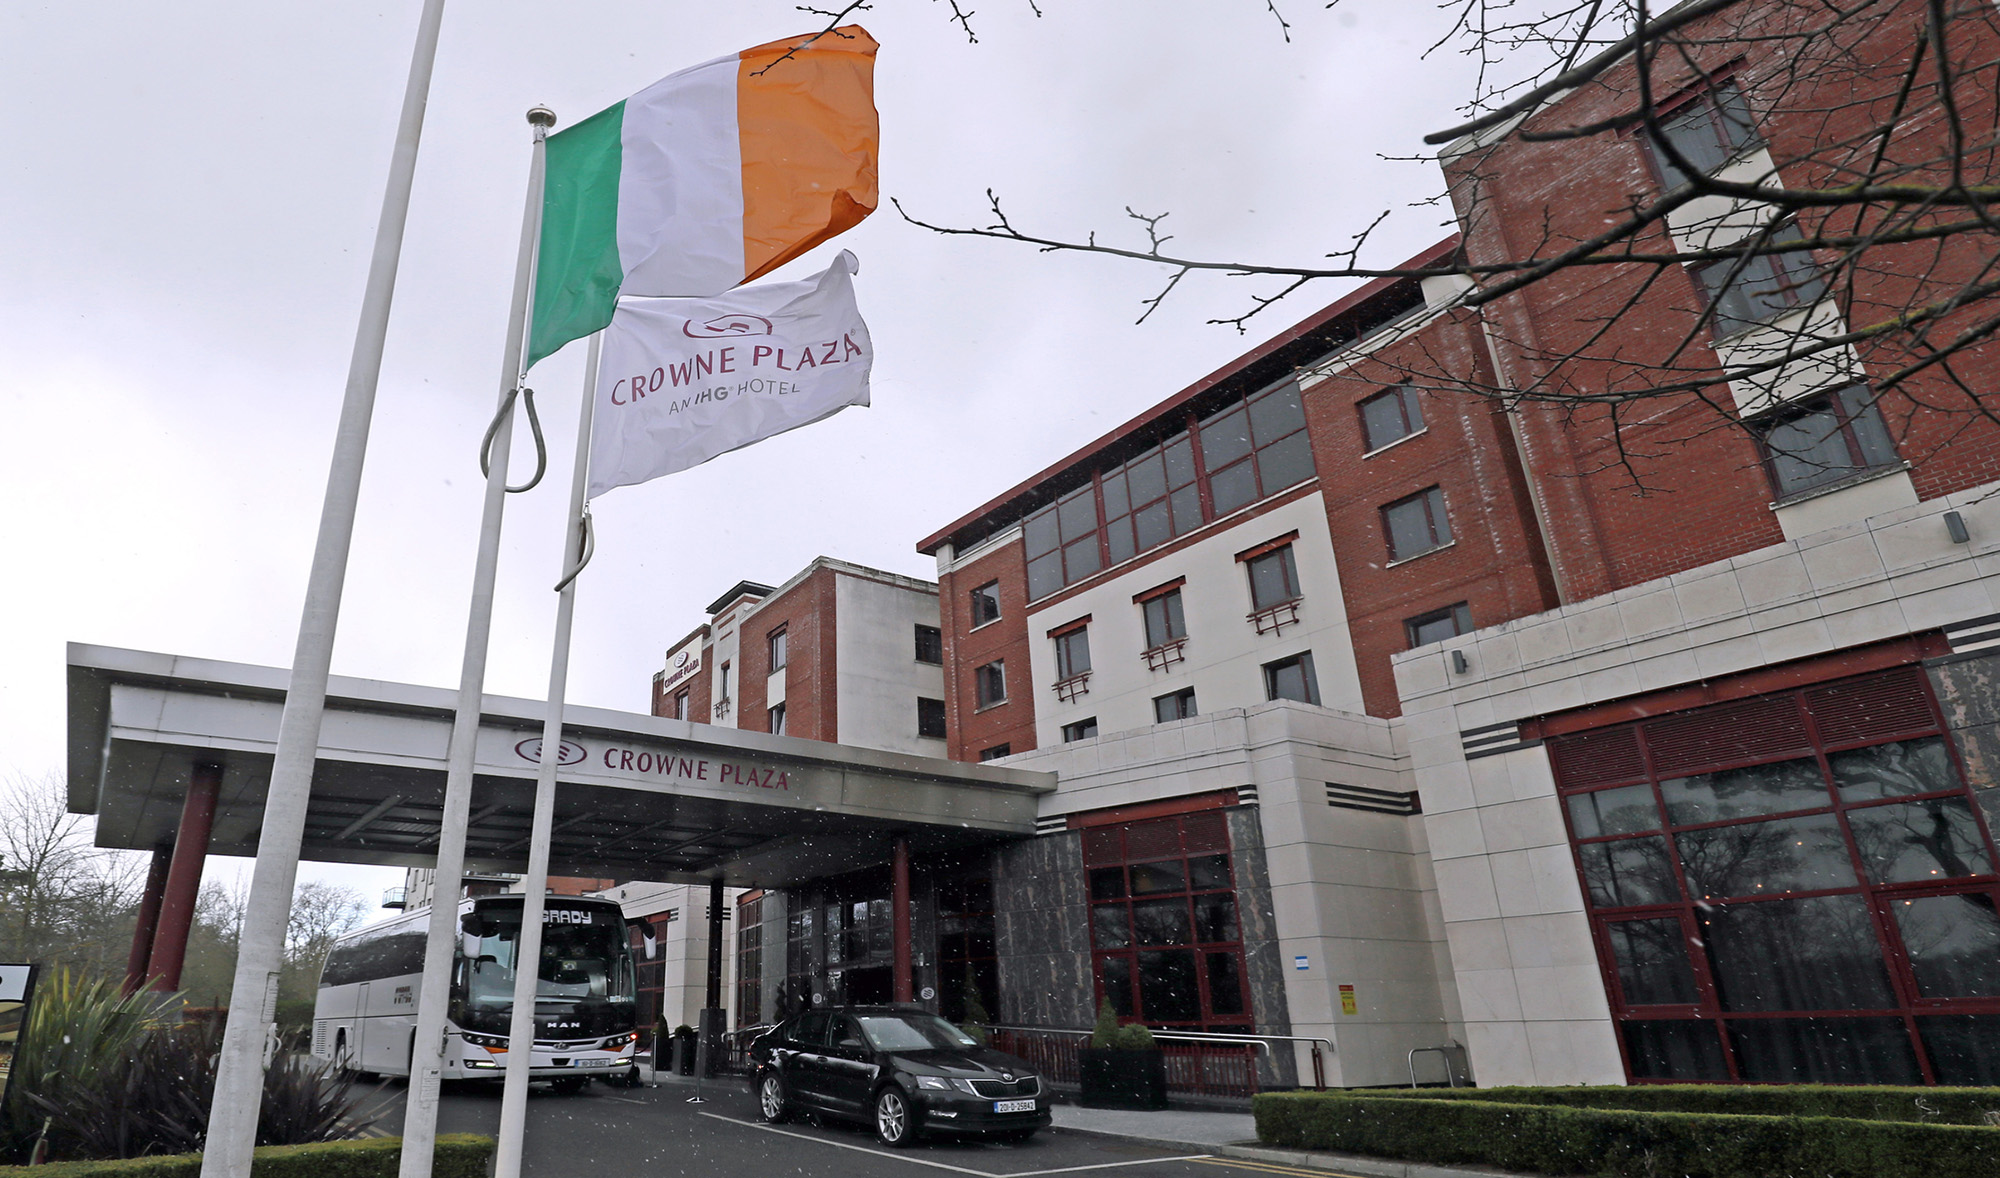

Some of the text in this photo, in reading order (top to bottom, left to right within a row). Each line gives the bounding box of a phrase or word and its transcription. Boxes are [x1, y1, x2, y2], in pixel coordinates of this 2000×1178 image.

[611, 333, 863, 406] CROWNE PLAZA
[669, 397, 692, 415] AN
[737, 378, 801, 395] HOTEL
[603, 748, 789, 791] CROWNE PLAZA
